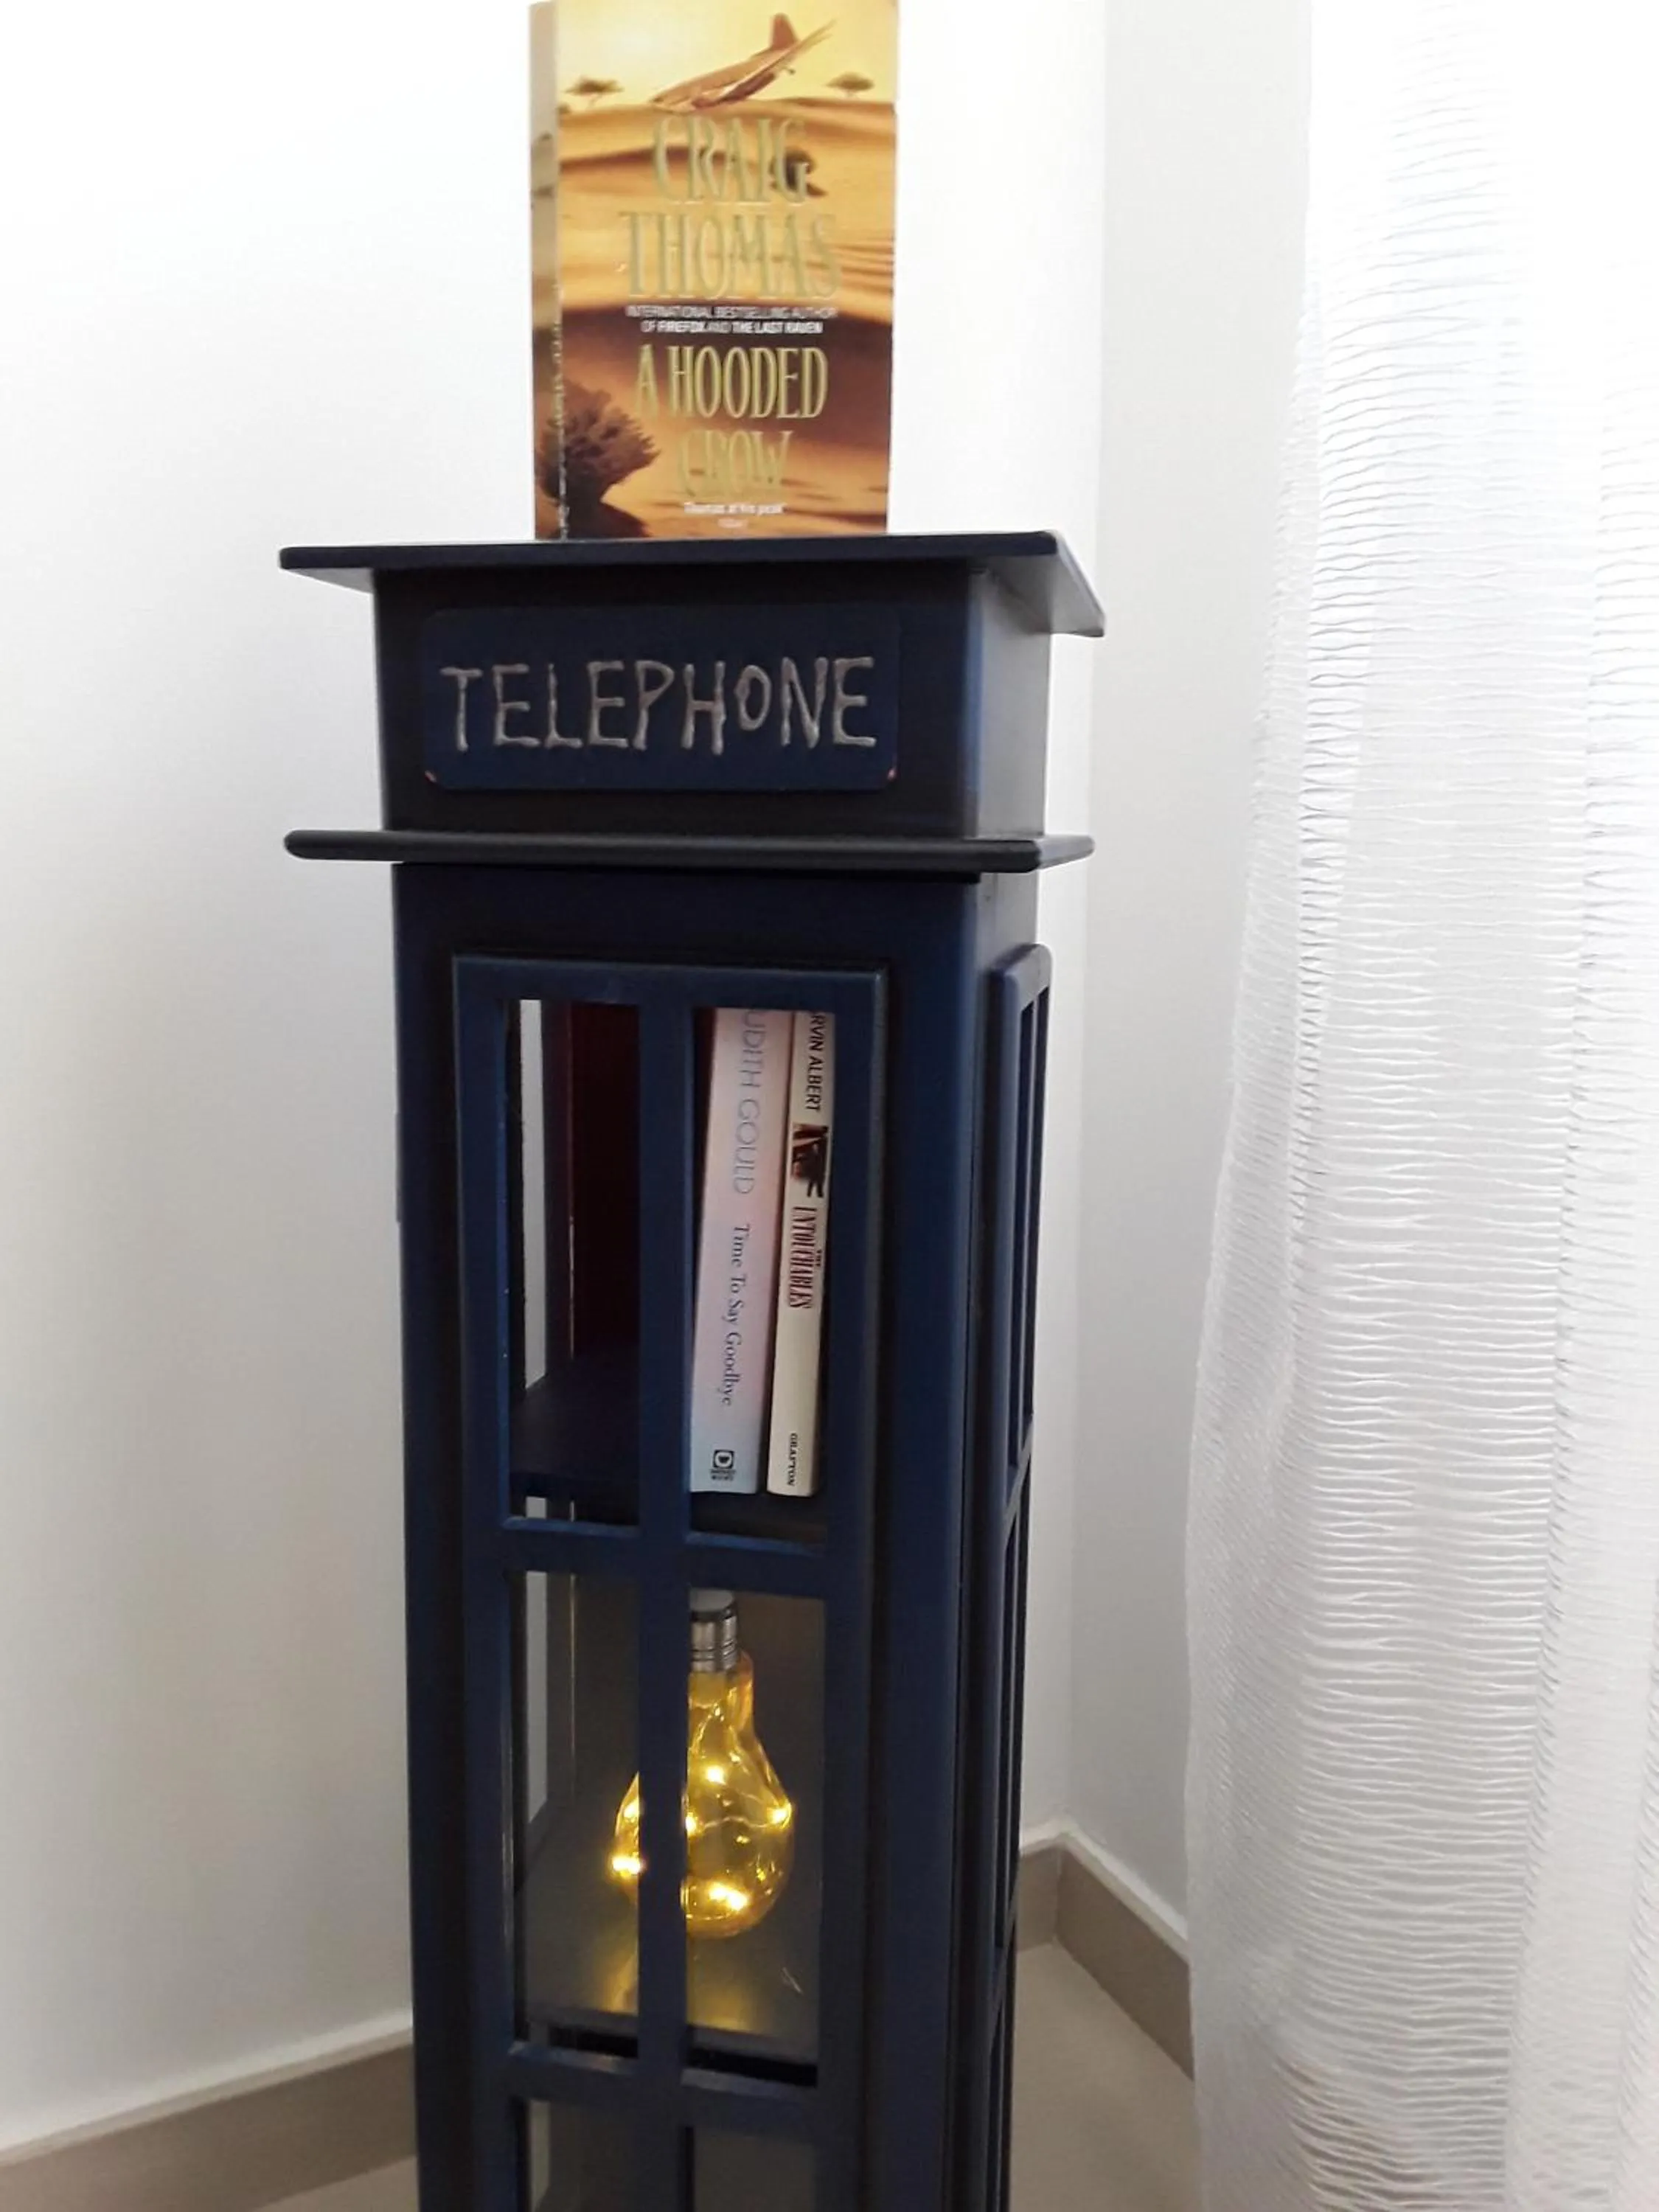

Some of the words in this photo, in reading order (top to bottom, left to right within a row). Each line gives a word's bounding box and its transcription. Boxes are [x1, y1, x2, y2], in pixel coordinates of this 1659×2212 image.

[653, 117, 810, 203] CRAIG
[619, 211, 842, 298] THOMAS
[641, 320, 655, 333] OF
[732, 321, 754, 333] THE
[755, 321, 782, 333] LAST
[633, 344, 658, 419] A
[666, 345, 829, 419] HOODED
[439, 657, 877, 755] TELEPHONE
[805, 1055, 825, 1111] ALBERT
[732, 1099, 760, 1195] GOULD
[729, 1223, 751, 1267] Time
[721, 1298, 745, 1325] Say
[729, 1273, 746, 1294] To
[717, 1331, 742, 1407] Goodbye
